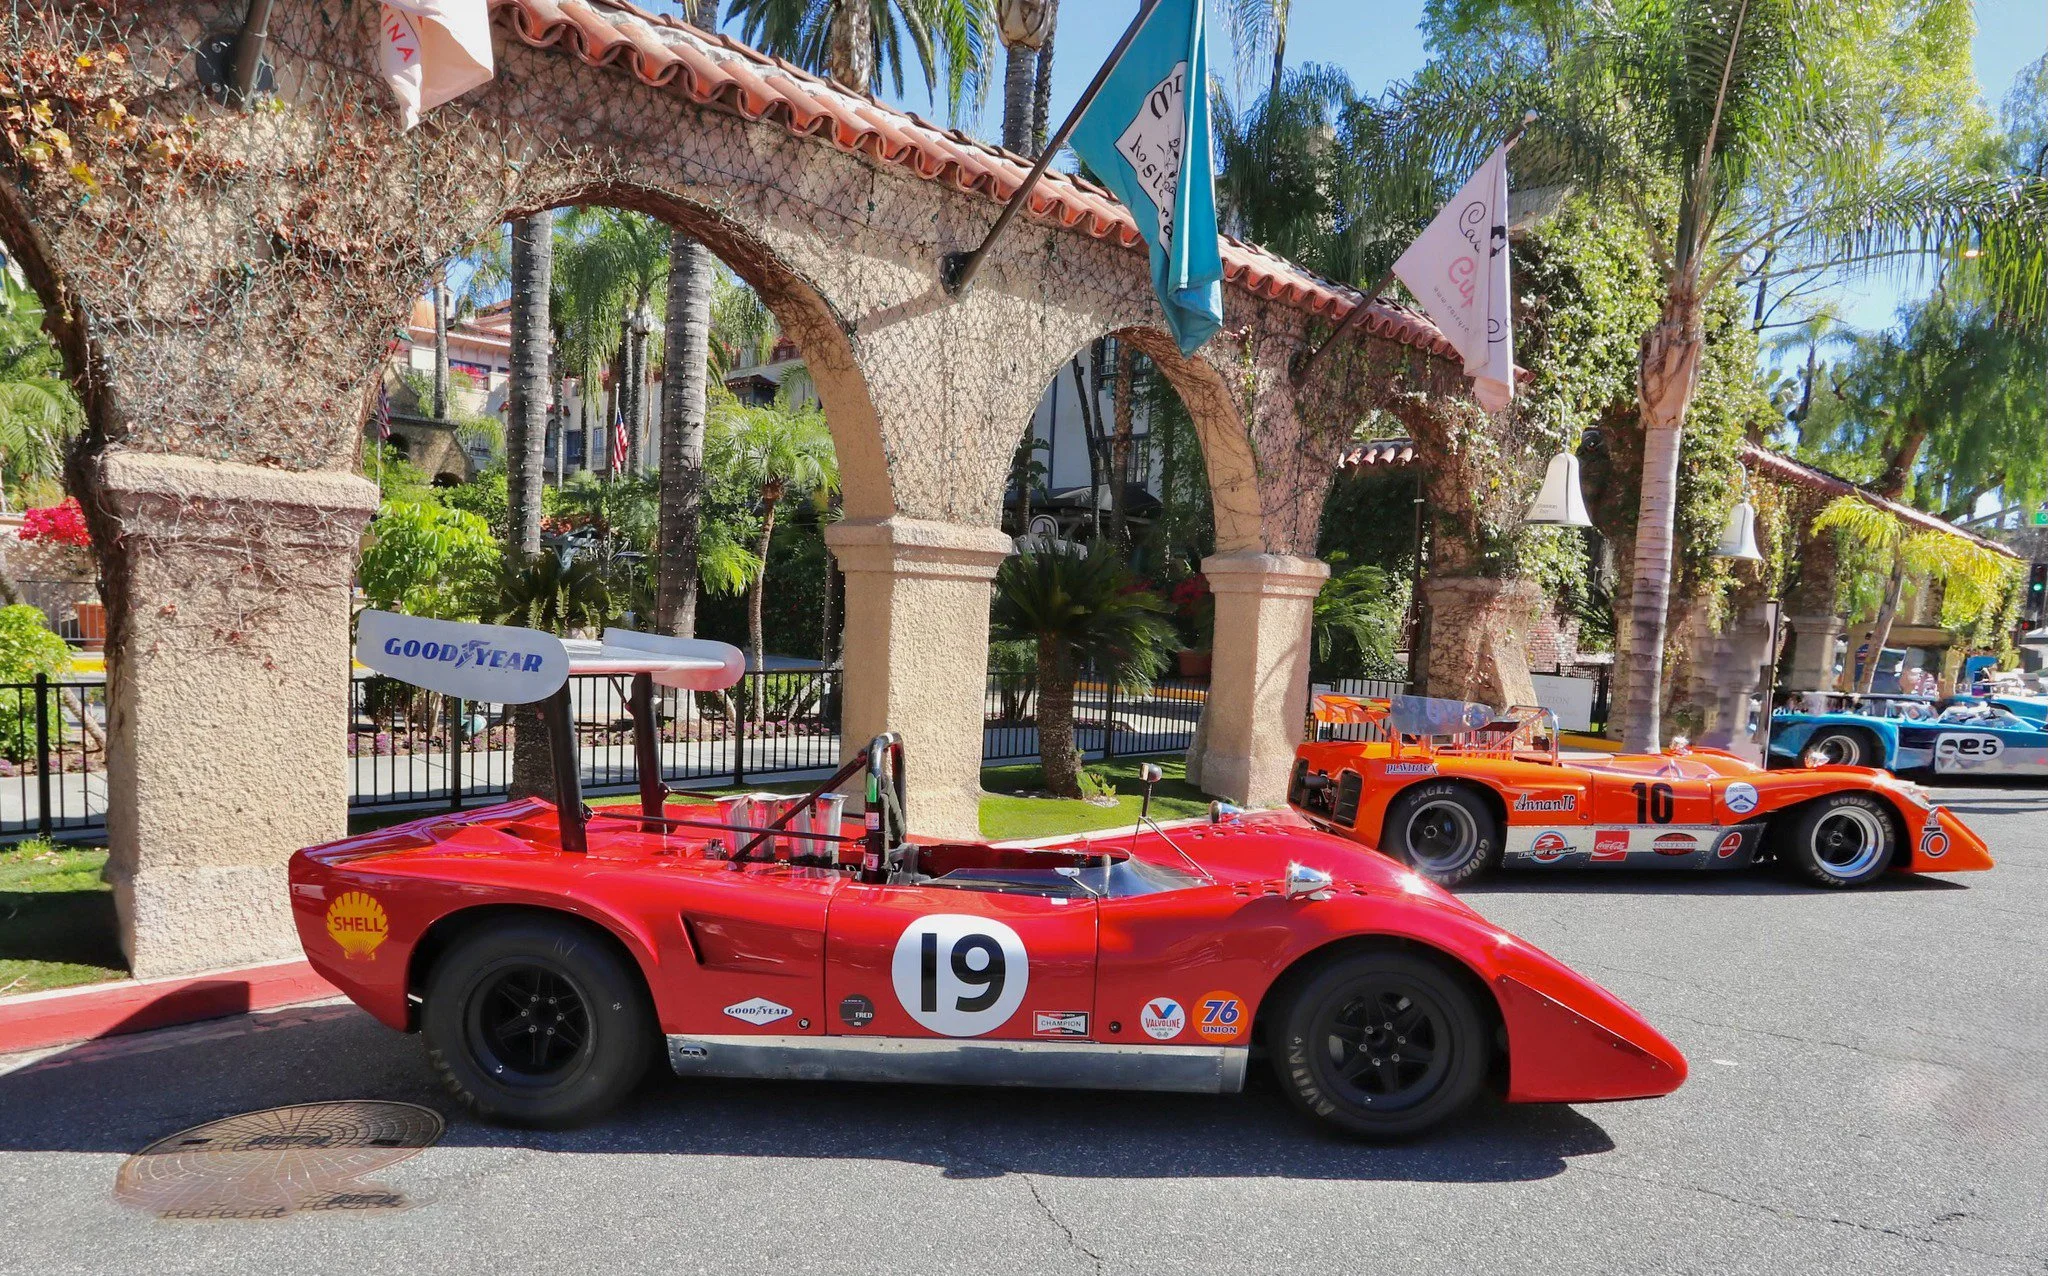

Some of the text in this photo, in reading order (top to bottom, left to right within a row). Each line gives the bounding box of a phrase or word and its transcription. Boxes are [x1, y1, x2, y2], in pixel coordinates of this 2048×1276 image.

[1409, 785, 1454, 806] EAGLE
[1514, 793, 1561, 811] Annan
[1632, 782, 1674, 824] 10
[333, 916, 383, 932] SHELL
[921, 933, 1006, 1012] 19
[1202, 1001, 1239, 1023] 76
[1145, 1018, 1180, 1028] VALVOLINE
[1203, 1026, 1237, 1034] UNION
